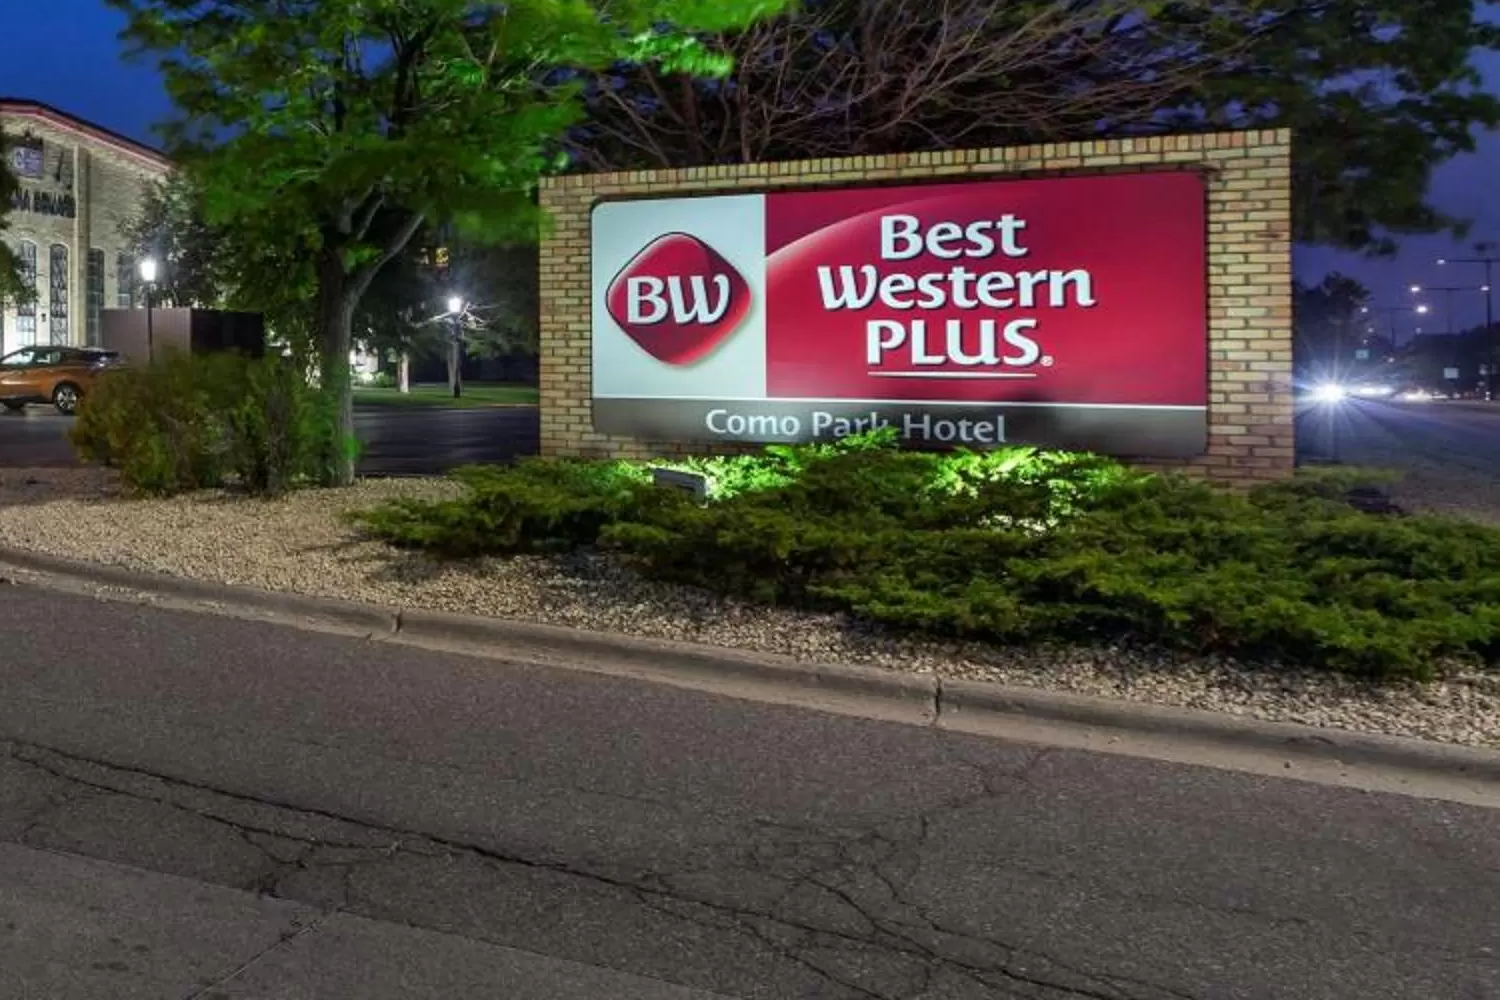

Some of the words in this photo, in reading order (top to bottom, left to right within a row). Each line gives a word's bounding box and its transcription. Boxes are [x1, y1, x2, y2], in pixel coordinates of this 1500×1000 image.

[880, 213, 1029, 260] Best
[627, 273, 731, 325] BW
[817, 263, 1098, 310] Western
[705, 408, 800, 436] Como
[903, 413, 1007, 443] Hotel
